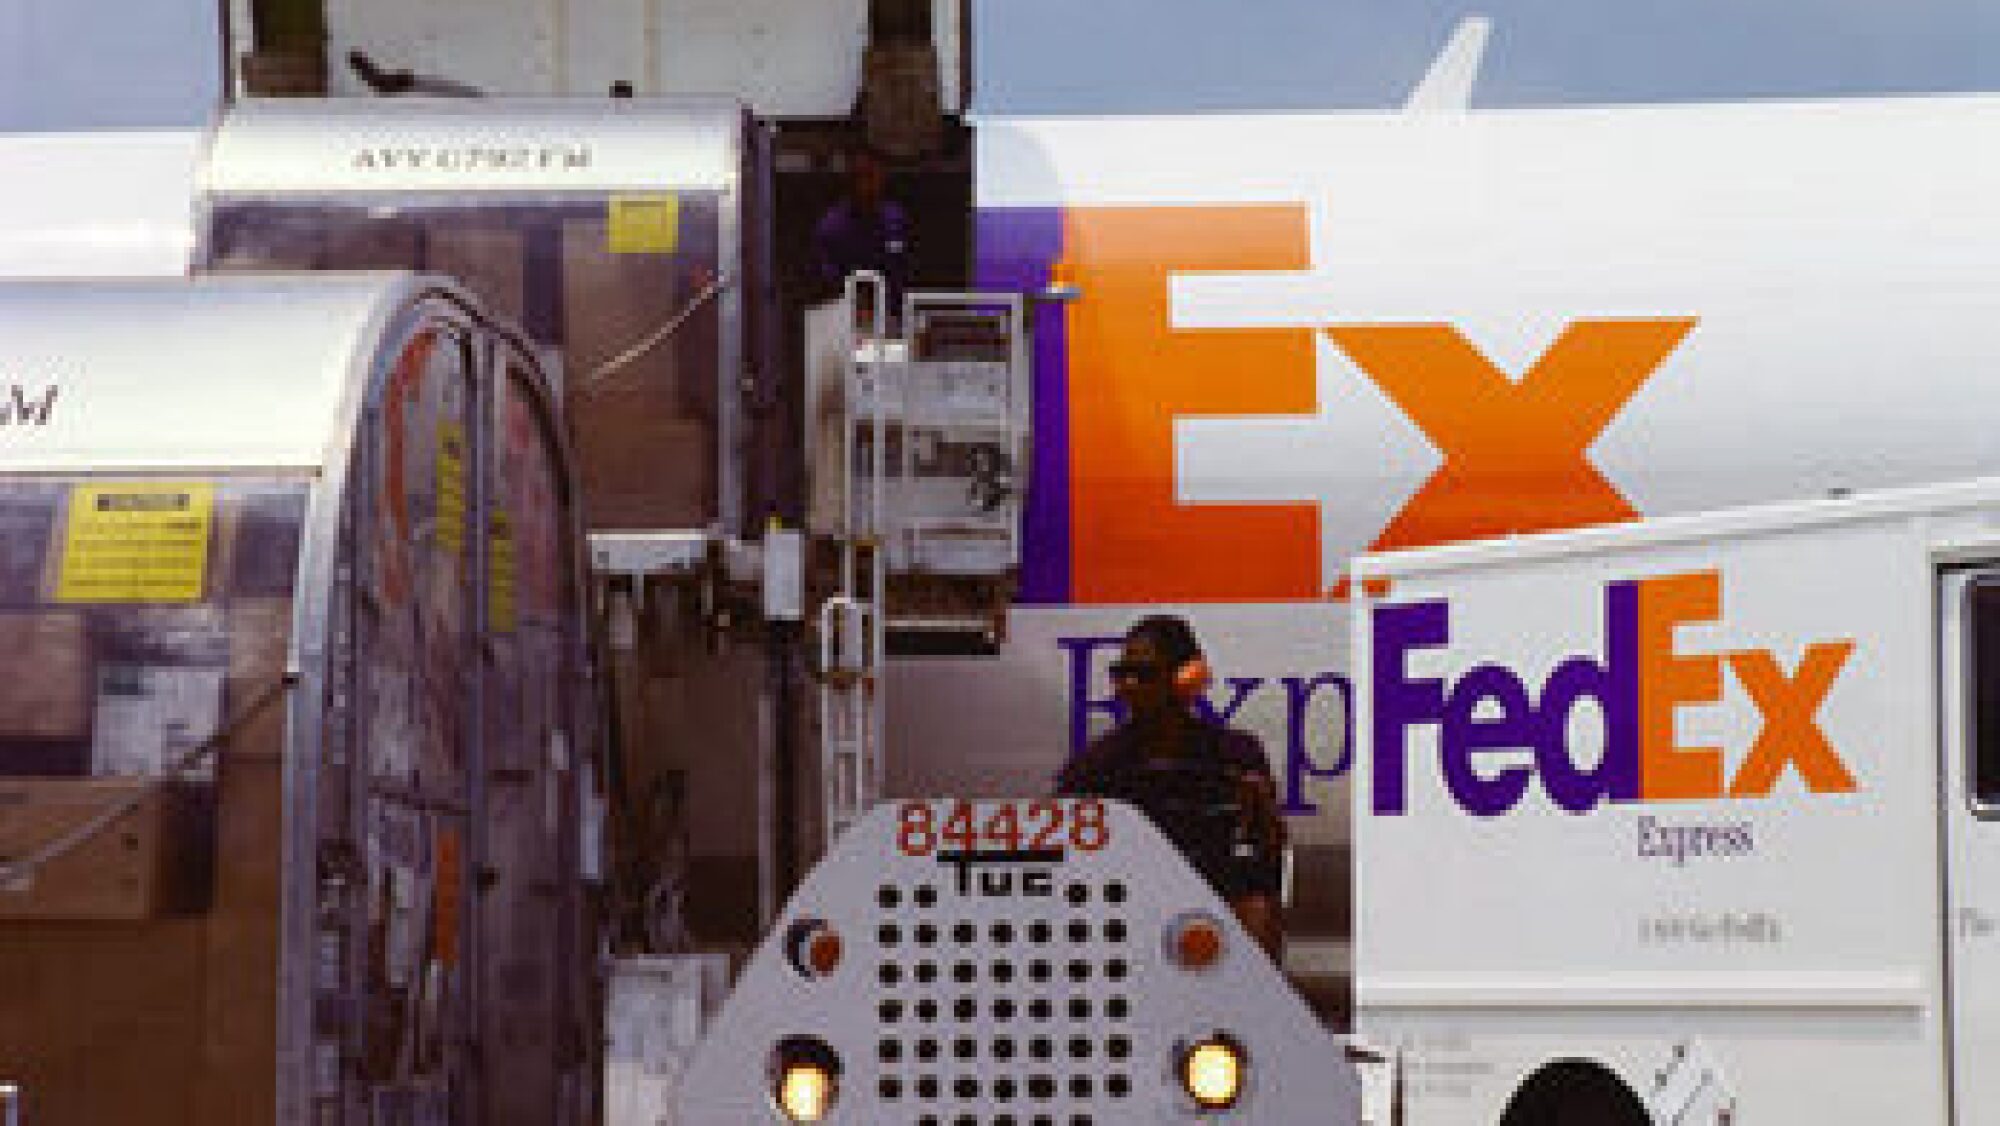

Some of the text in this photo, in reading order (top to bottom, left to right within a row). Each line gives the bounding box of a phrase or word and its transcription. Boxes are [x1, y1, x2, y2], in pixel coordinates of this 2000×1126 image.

[1371, 569, 1858, 818] FedEx
[896, 800, 1110, 857] 84428
[1637, 815, 1755, 866] Express
